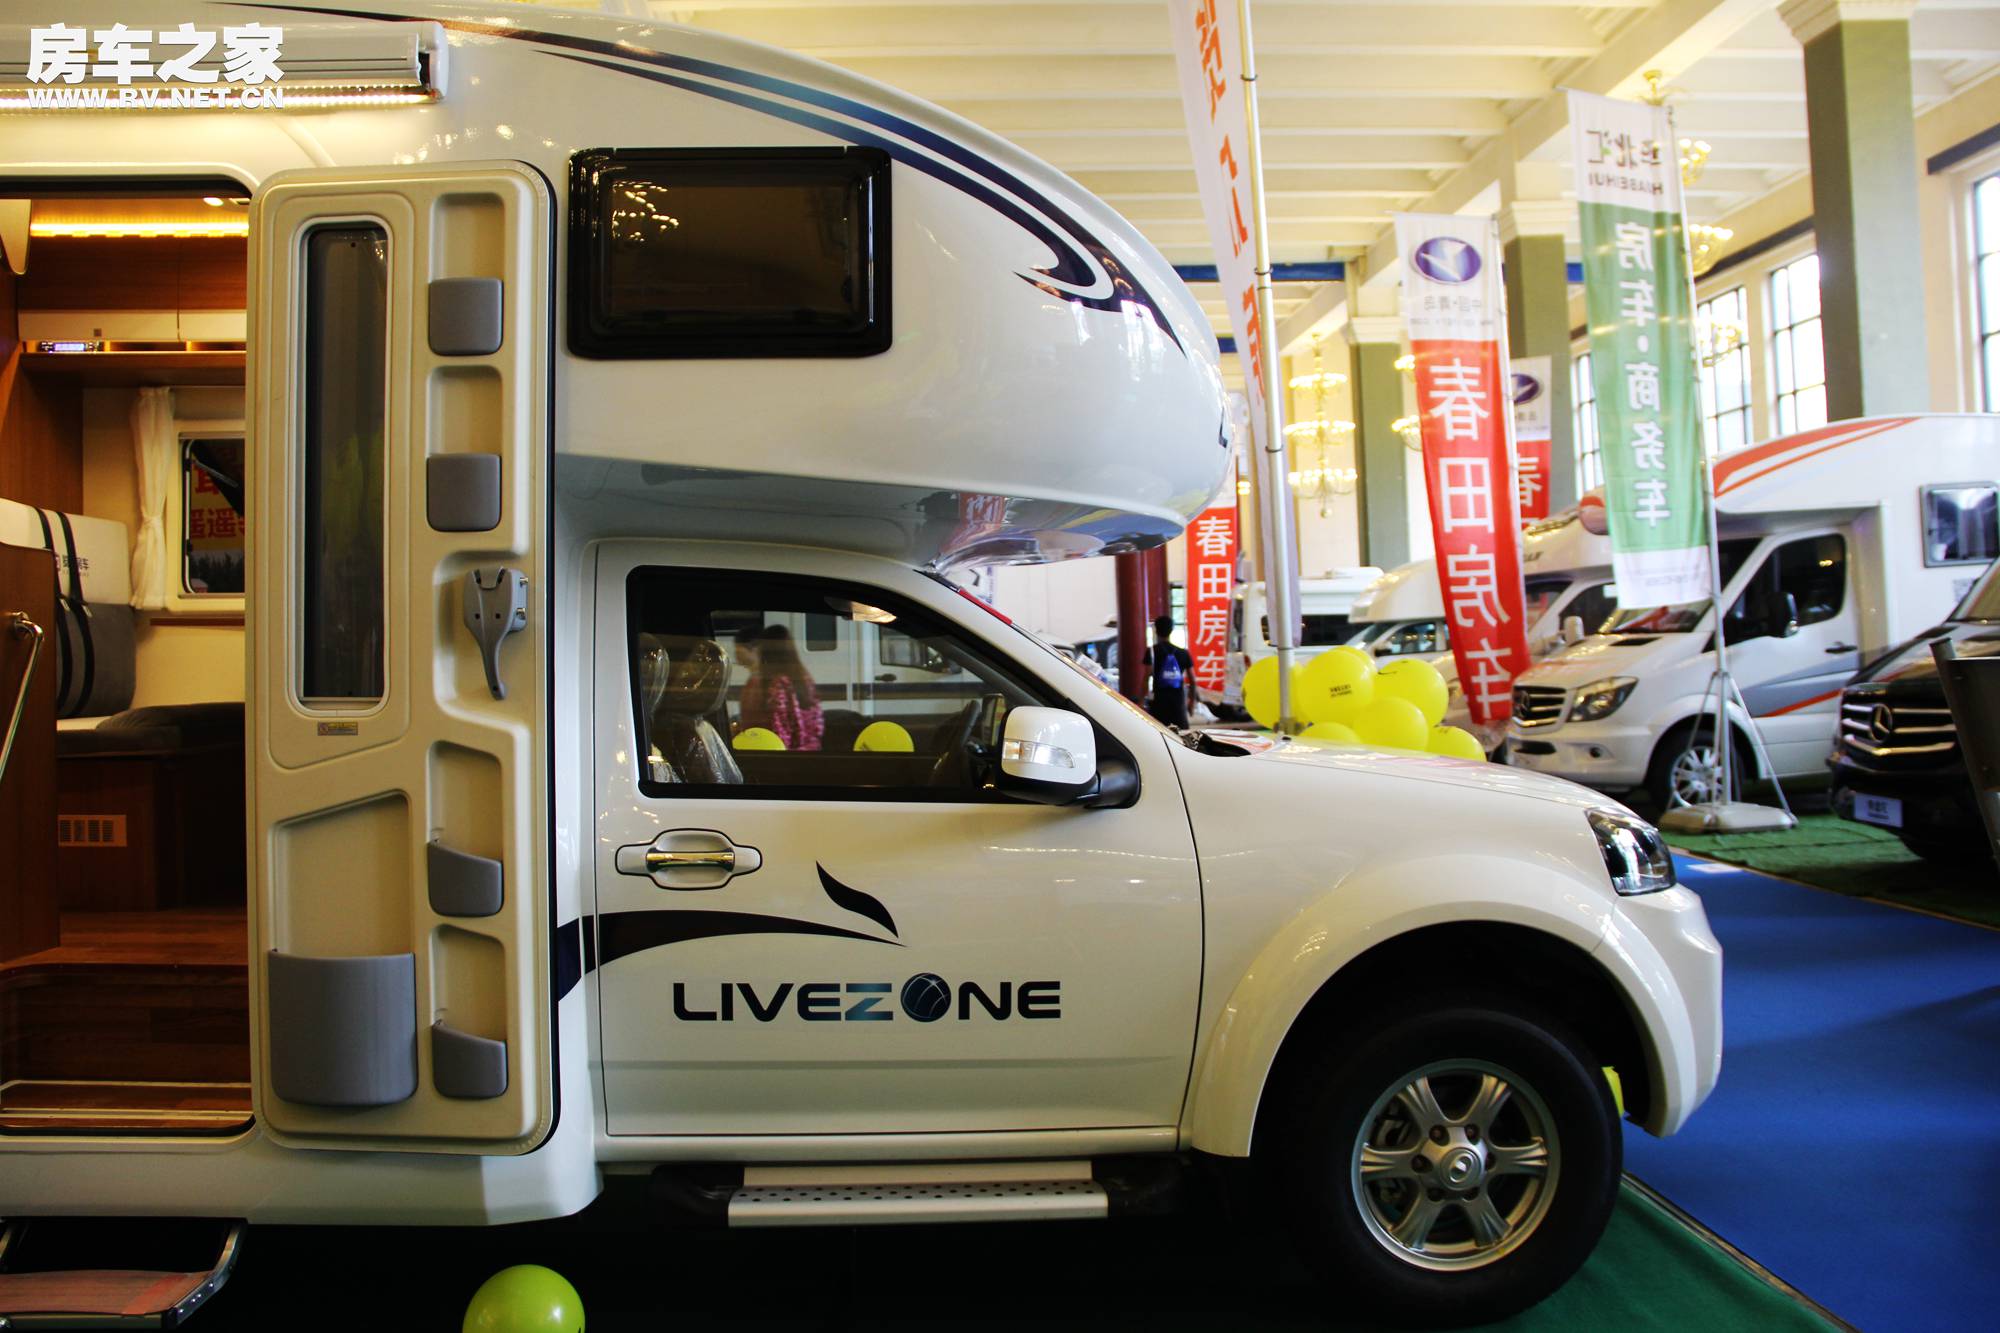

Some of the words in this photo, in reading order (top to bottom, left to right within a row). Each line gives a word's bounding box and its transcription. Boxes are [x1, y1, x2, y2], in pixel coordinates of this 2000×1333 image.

[1195, 516, 1233, 689] 春田房车
[673, 972, 1061, 1023] LIVEZONE
